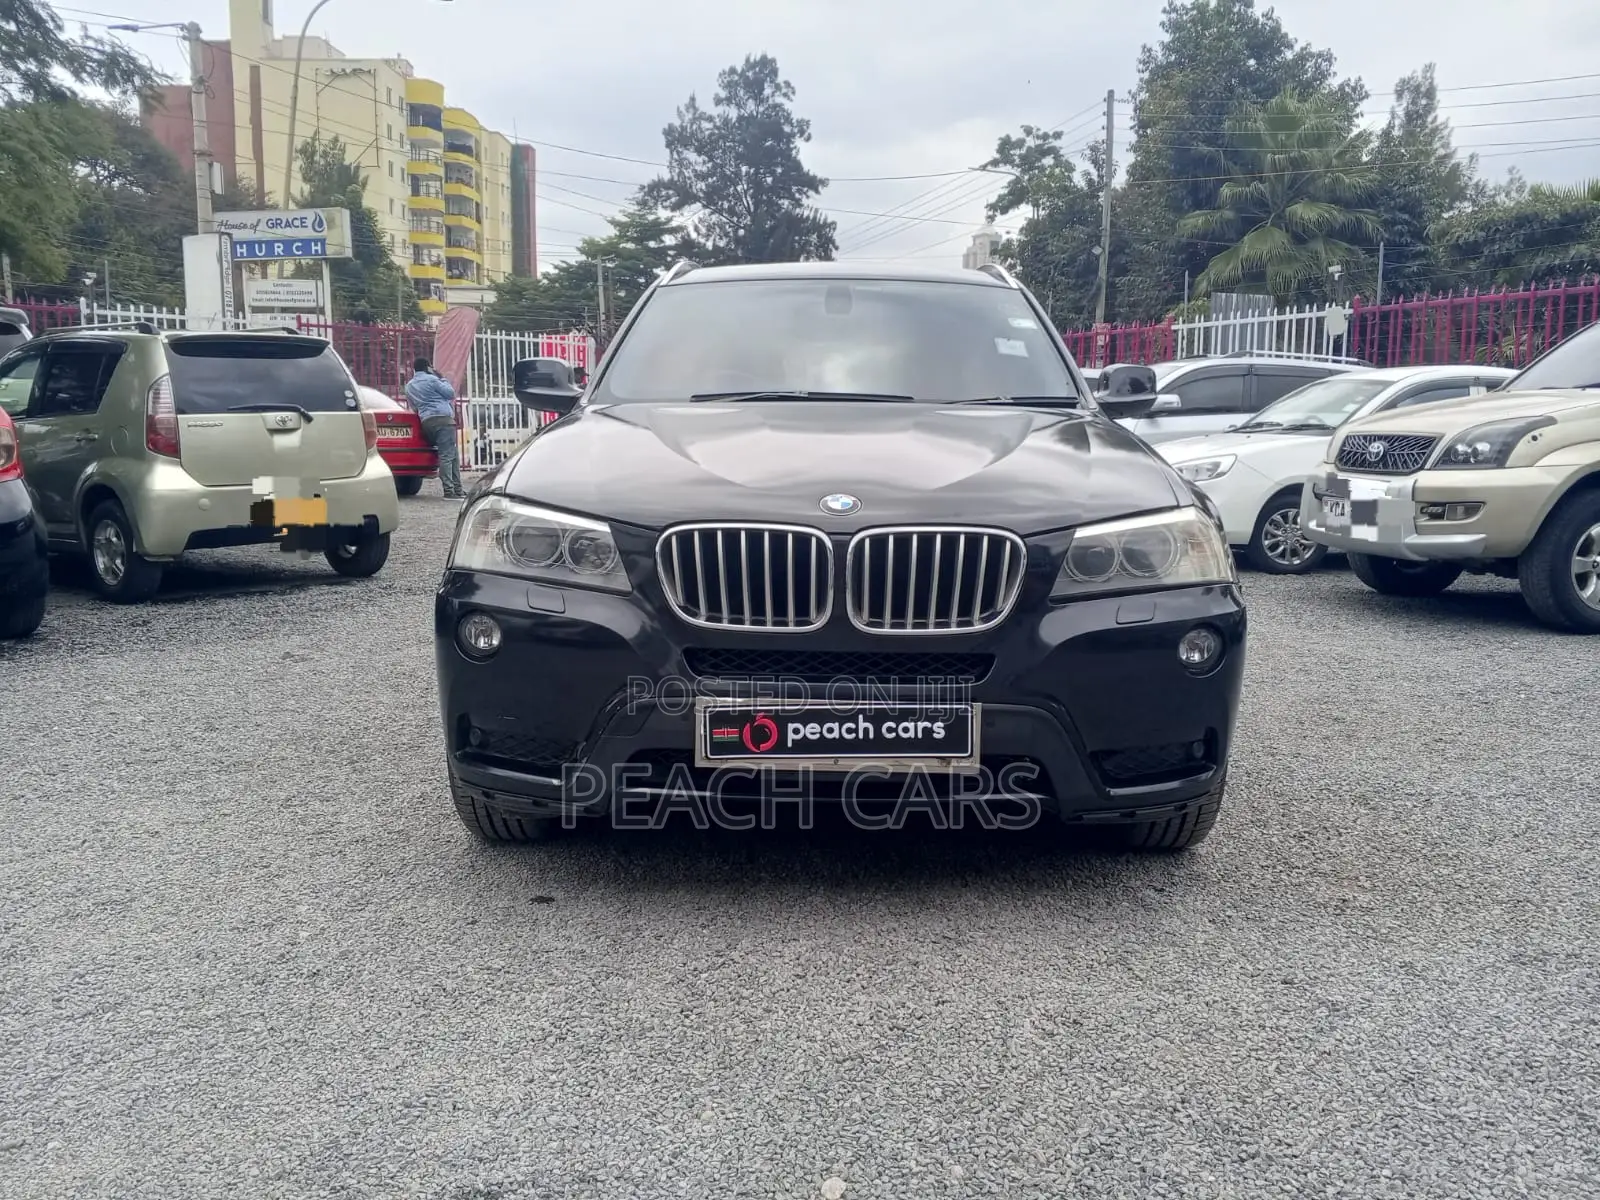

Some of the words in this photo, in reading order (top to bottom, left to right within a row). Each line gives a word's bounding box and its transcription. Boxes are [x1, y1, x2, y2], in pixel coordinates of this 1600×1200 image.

[249, 217, 262, 234] of
[266, 216, 308, 230] GRACE
[236, 242, 322, 257] HURCH
[786, 715, 875, 748] peach
[880, 721, 946, 740] cars
